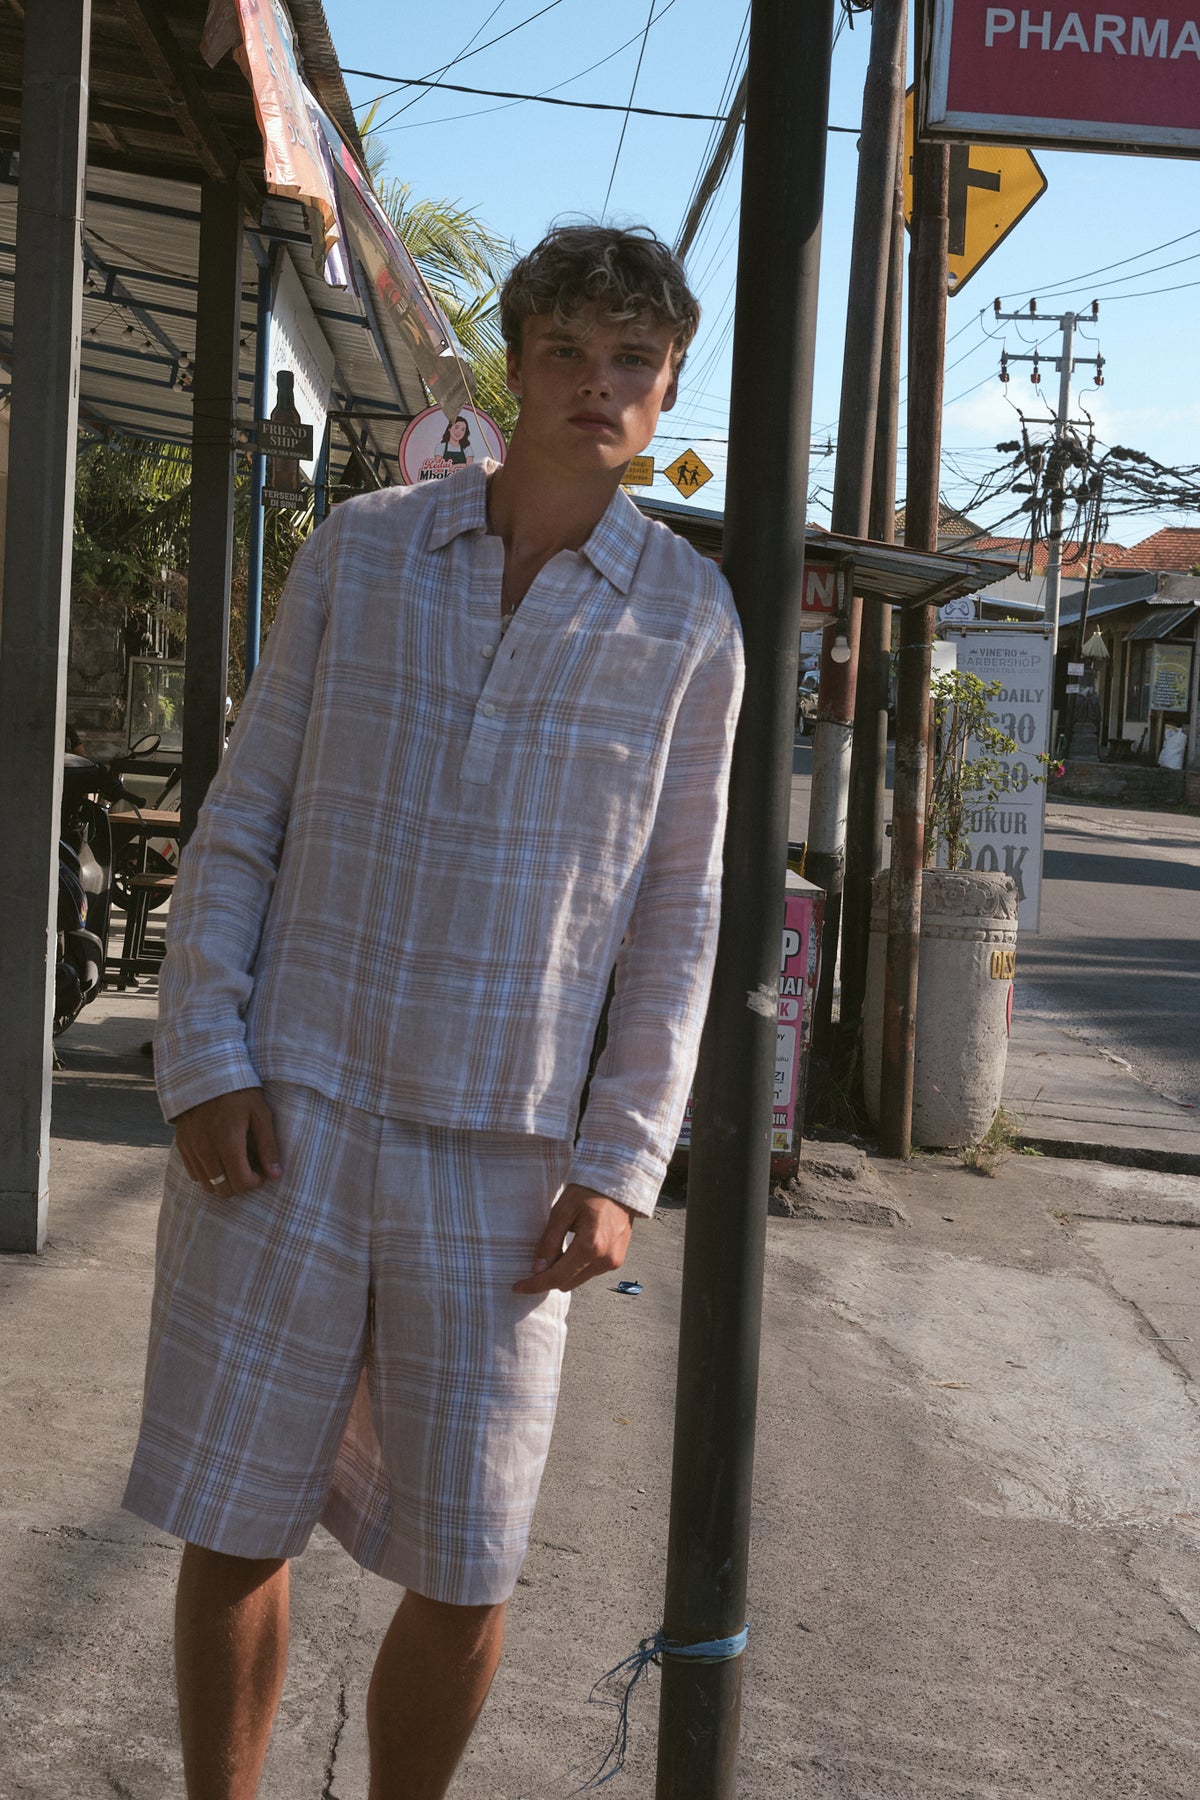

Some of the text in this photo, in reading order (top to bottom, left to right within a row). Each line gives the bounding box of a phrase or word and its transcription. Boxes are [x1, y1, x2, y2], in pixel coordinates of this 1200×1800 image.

[985, 8, 1200, 60] PHARMA
[262, 423, 307, 438] FRIEND
[270, 435, 299, 448] SHIP
[263, 489, 304, 502] TERSEDIA
[270, 499, 297, 509] DI SINI
[997, 688, 1044, 703] DAILY
